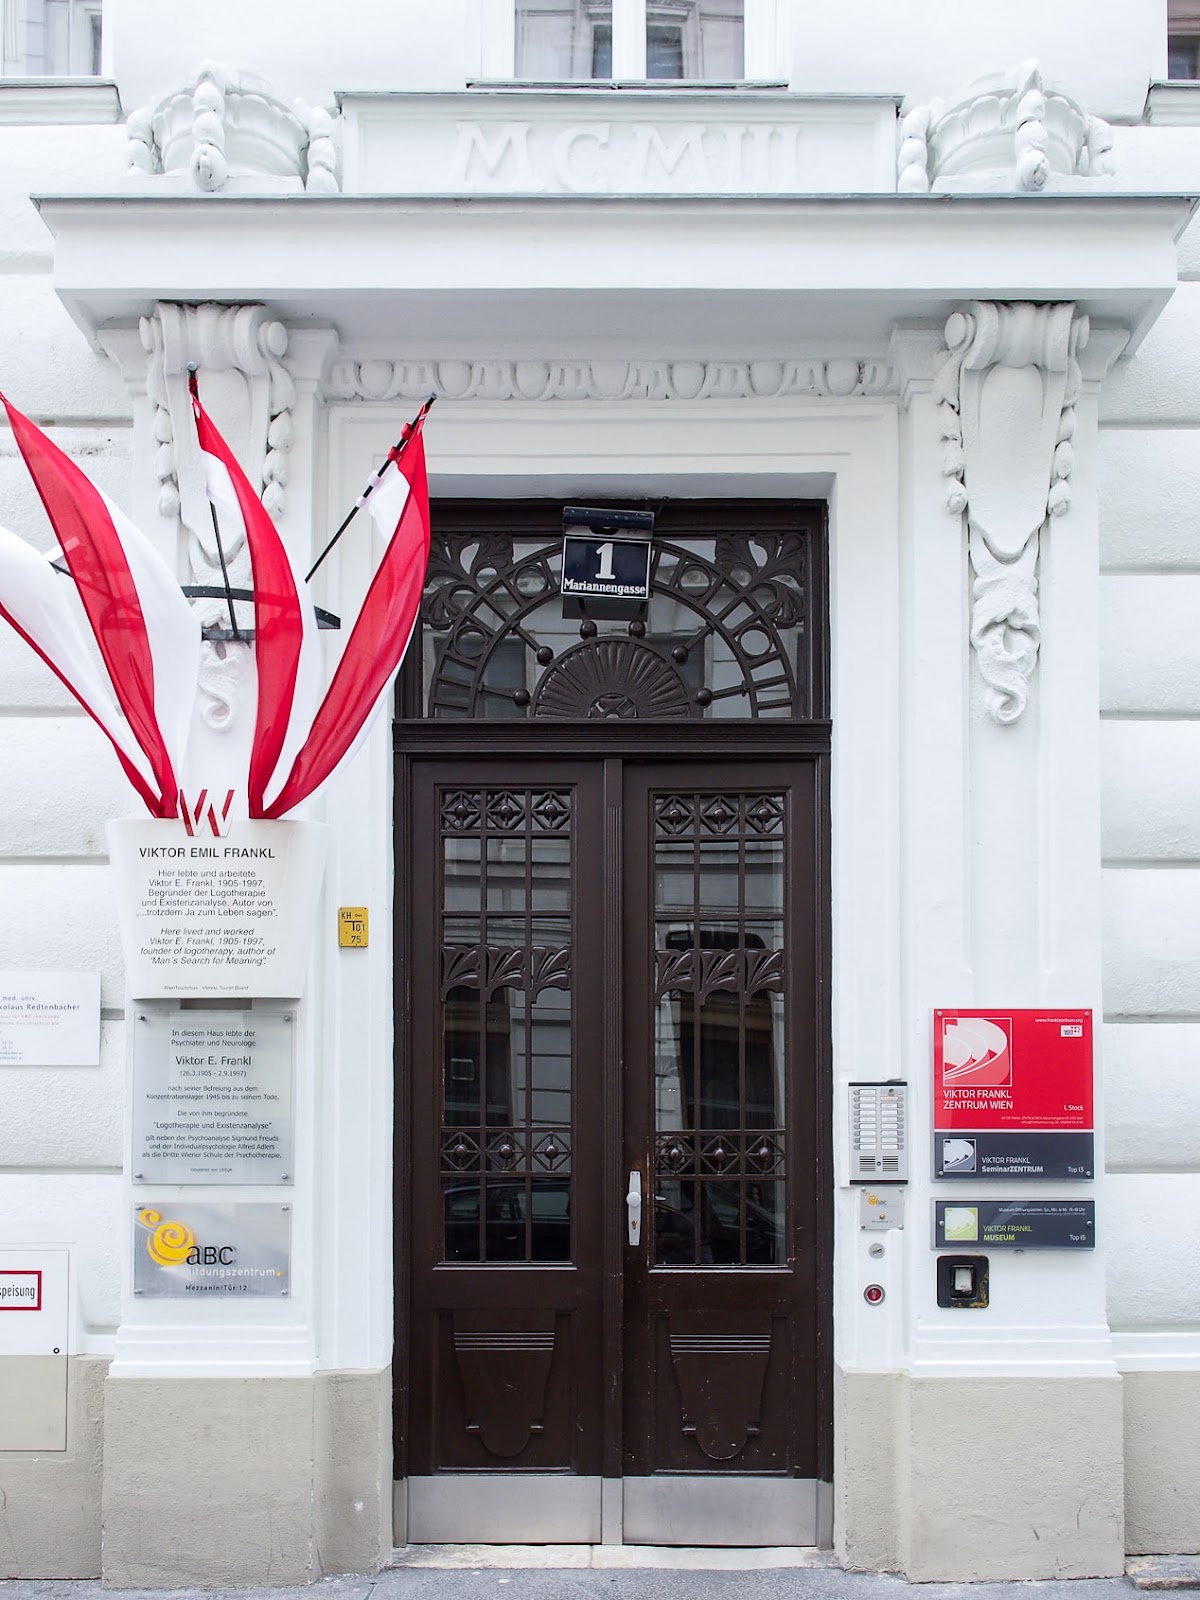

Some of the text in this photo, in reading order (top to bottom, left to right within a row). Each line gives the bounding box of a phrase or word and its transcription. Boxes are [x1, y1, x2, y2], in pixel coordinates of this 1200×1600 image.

[595, 543, 616, 579] 1
[564, 578, 646, 595] Mariannengasse
[139, 848, 276, 858] VIKTOR EMIL FRANKL
[186, 880, 214, 888] Frankl,
[148, 889, 192, 898] Begründer
[210, 889, 266, 898] Logotherapie
[159, 899, 229, 908] Existenzanalyse,
[186, 938, 214, 946] Frankl,
[184, 947, 235, 957] logotherapy,
[176, 1056, 251, 1065] Viktor E. Frankl
[943, 1090, 1012, 1098] VIKTOR FRANKL
[943, 1100, 1013, 1109] ZENTRUM WIEN
